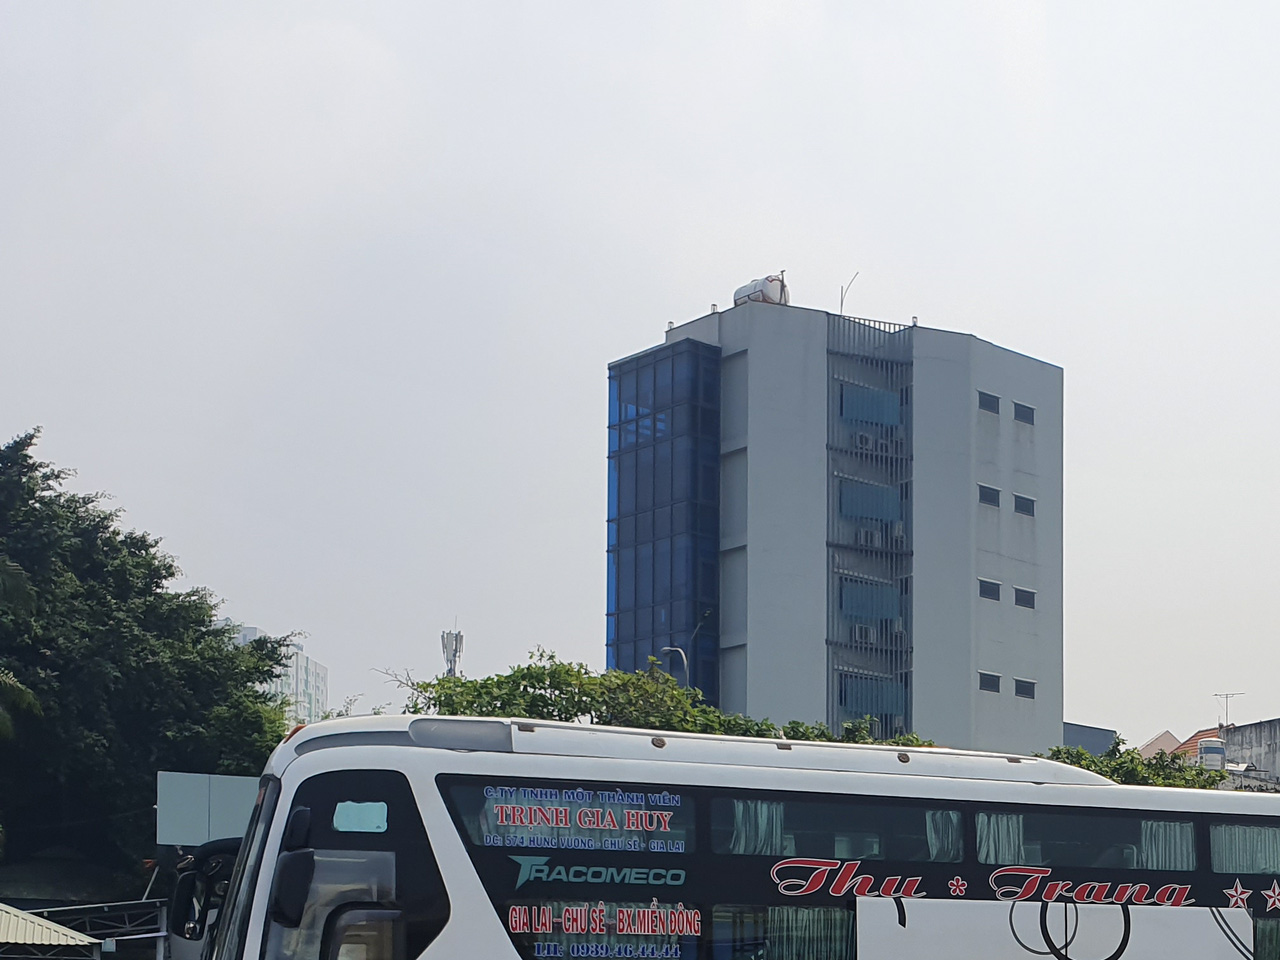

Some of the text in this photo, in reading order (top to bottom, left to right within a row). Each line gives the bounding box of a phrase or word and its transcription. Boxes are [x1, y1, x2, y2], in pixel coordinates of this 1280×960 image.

[521, 788, 559, 800] TNHH
[597, 788, 645, 804] THÀNH
[648, 791, 680, 806] VIÊN
[494, 804, 673, 832] TRỊNH GIA HUY
[507, 855, 686, 891] TRACOMECO
[770, 857, 928, 899] Thu
[509, 905, 530, 933] GIA
[532, 906, 552, 933] LAI
[562, 902, 589, 934] CHƯ
[590, 901, 606, 934] SÊ
[668, 902, 701, 935] ĐÔNG
